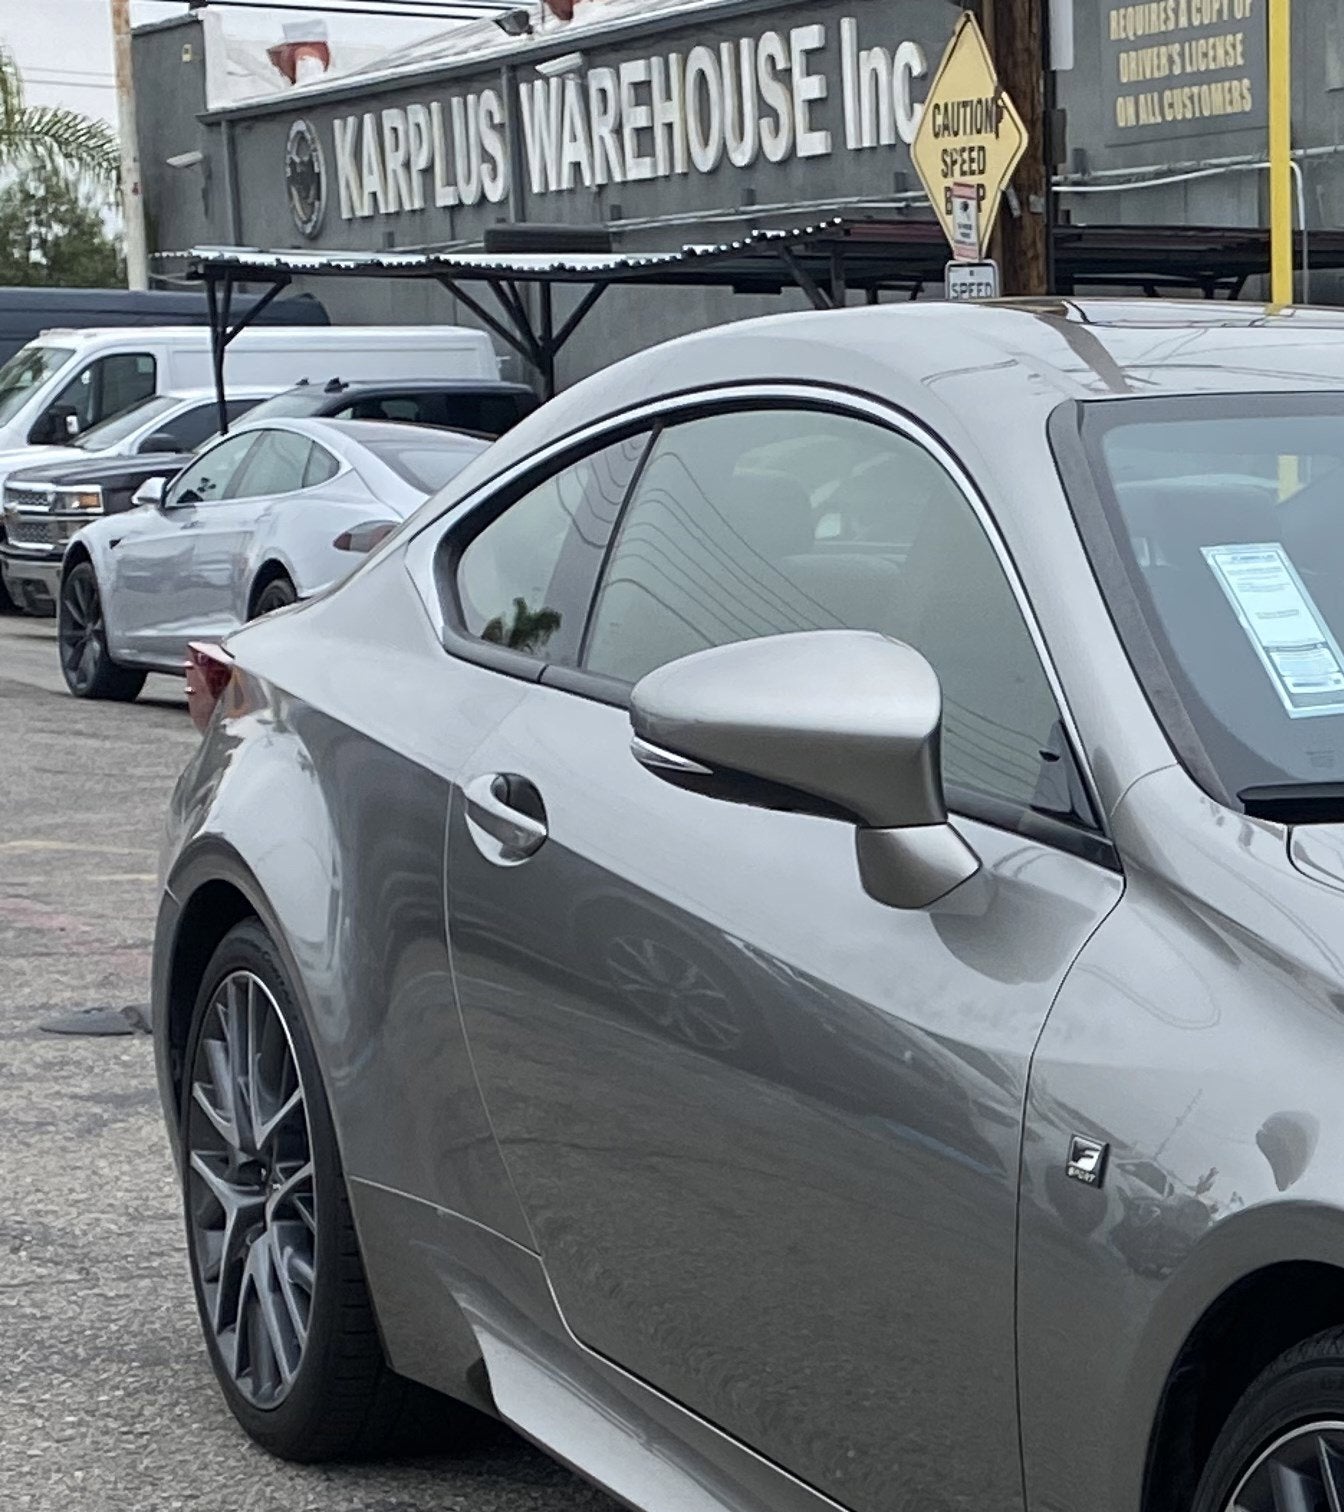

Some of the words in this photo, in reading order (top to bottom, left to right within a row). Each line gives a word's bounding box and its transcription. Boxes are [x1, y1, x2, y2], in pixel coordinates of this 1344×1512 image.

[1109, 0, 1176, 40] REQUIRES
[1119, 42, 1181, 83] DRIVER'S
[1184, 32, 1244, 73] LICENSE
[333, 89, 510, 219] KARPLUS
[519, 22, 832, 194] WAREHOUSE
[840, 16, 928, 150] Inc
[1116, 96, 1136, 127] ON
[1138, 91, 1162, 125] ALL
[1163, 78, 1252, 121] CUSTOMERS
[941, 145, 987, 179] SPEED
[945, 183, 986, 216] BP
